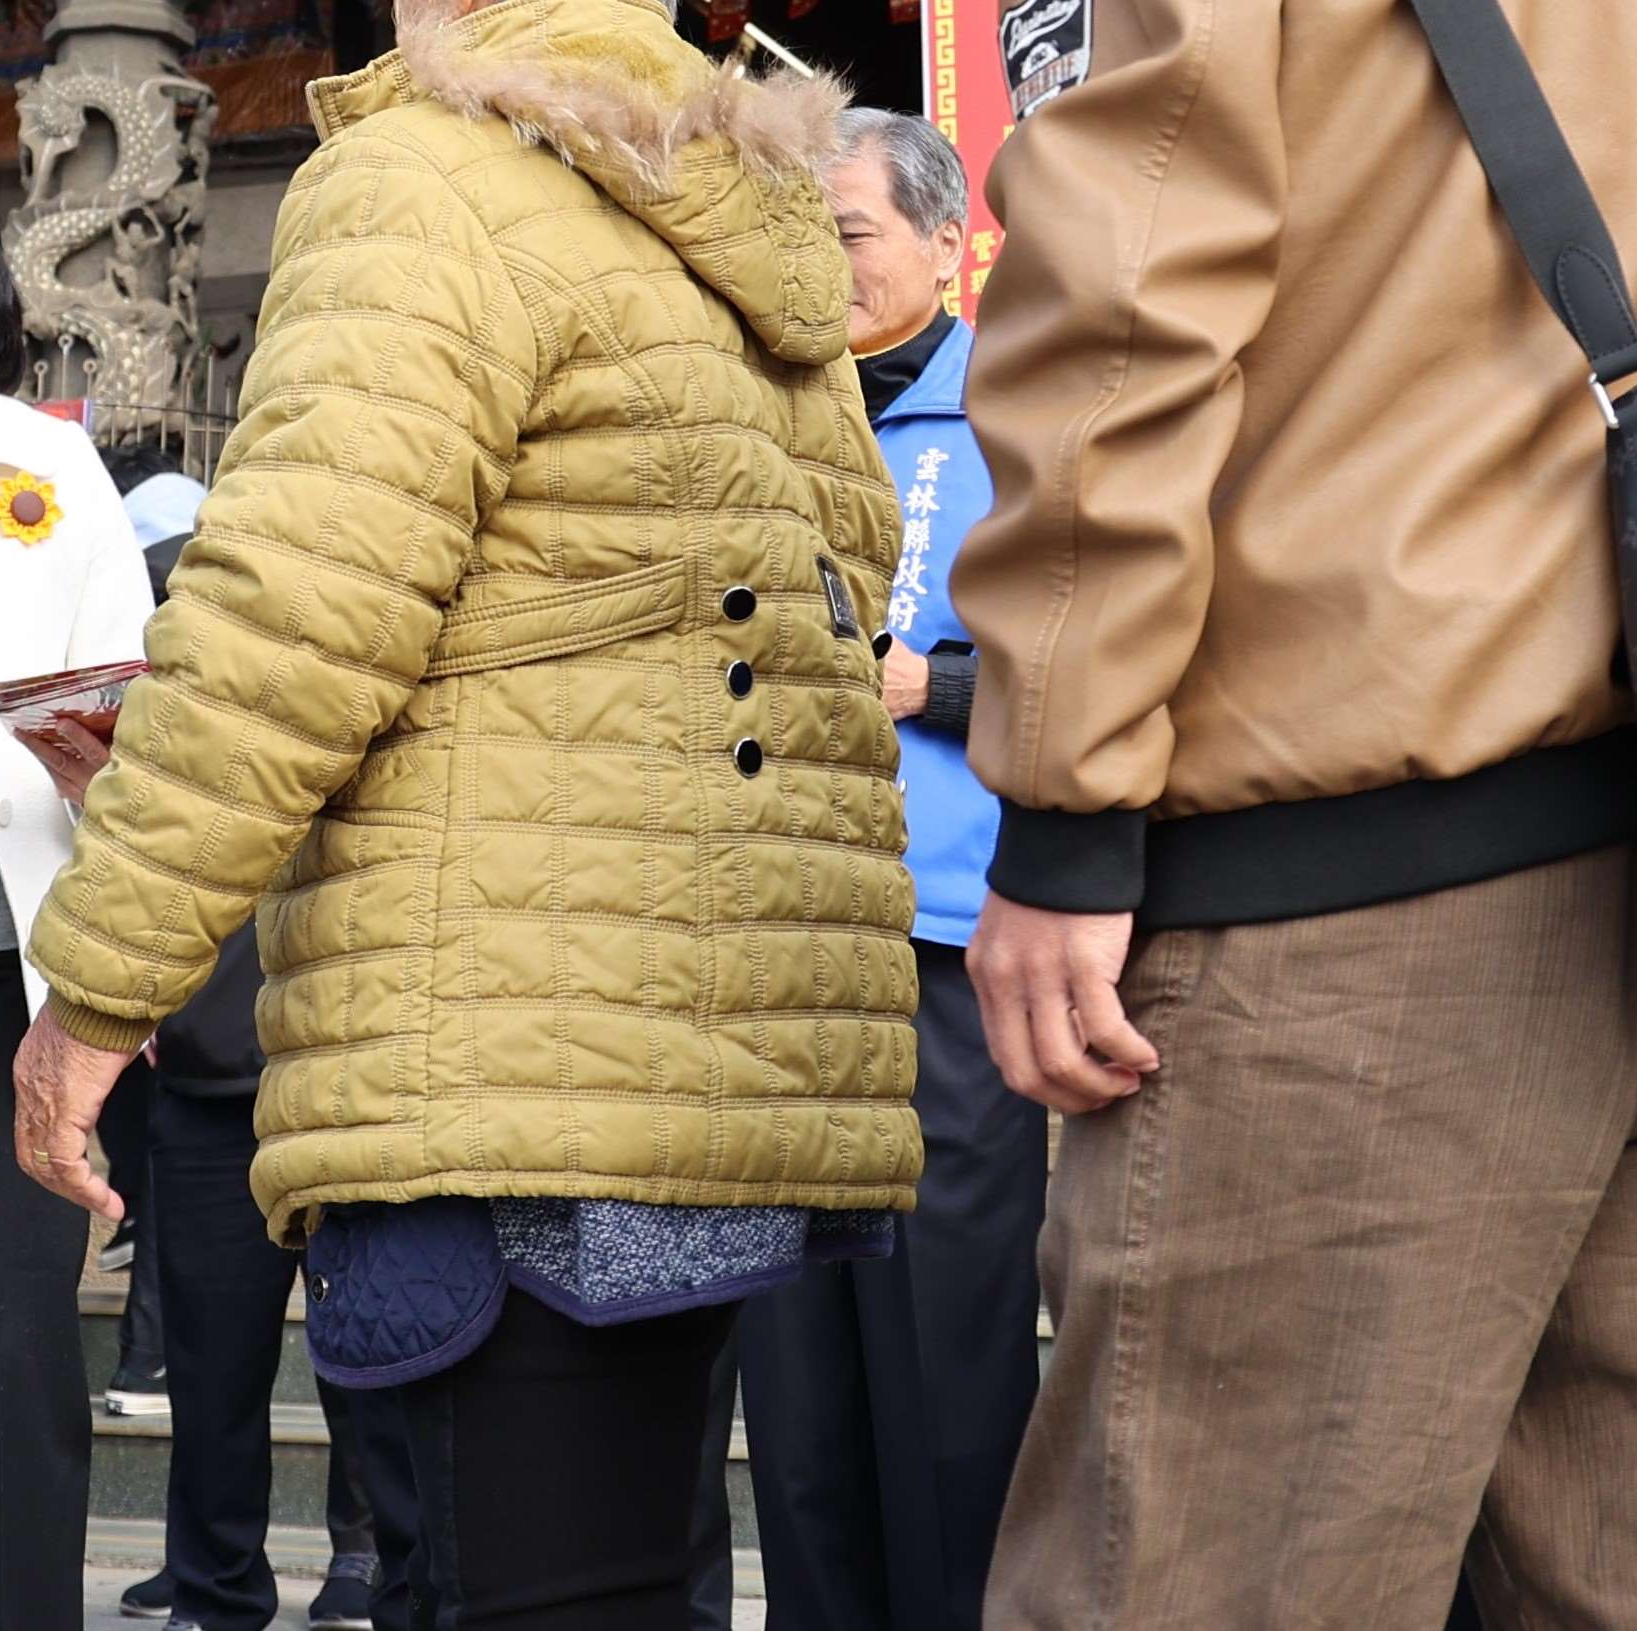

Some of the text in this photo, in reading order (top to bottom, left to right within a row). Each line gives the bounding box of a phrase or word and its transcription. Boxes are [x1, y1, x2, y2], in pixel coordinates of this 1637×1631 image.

[887, 447, 950, 632] 雲林縣政府
